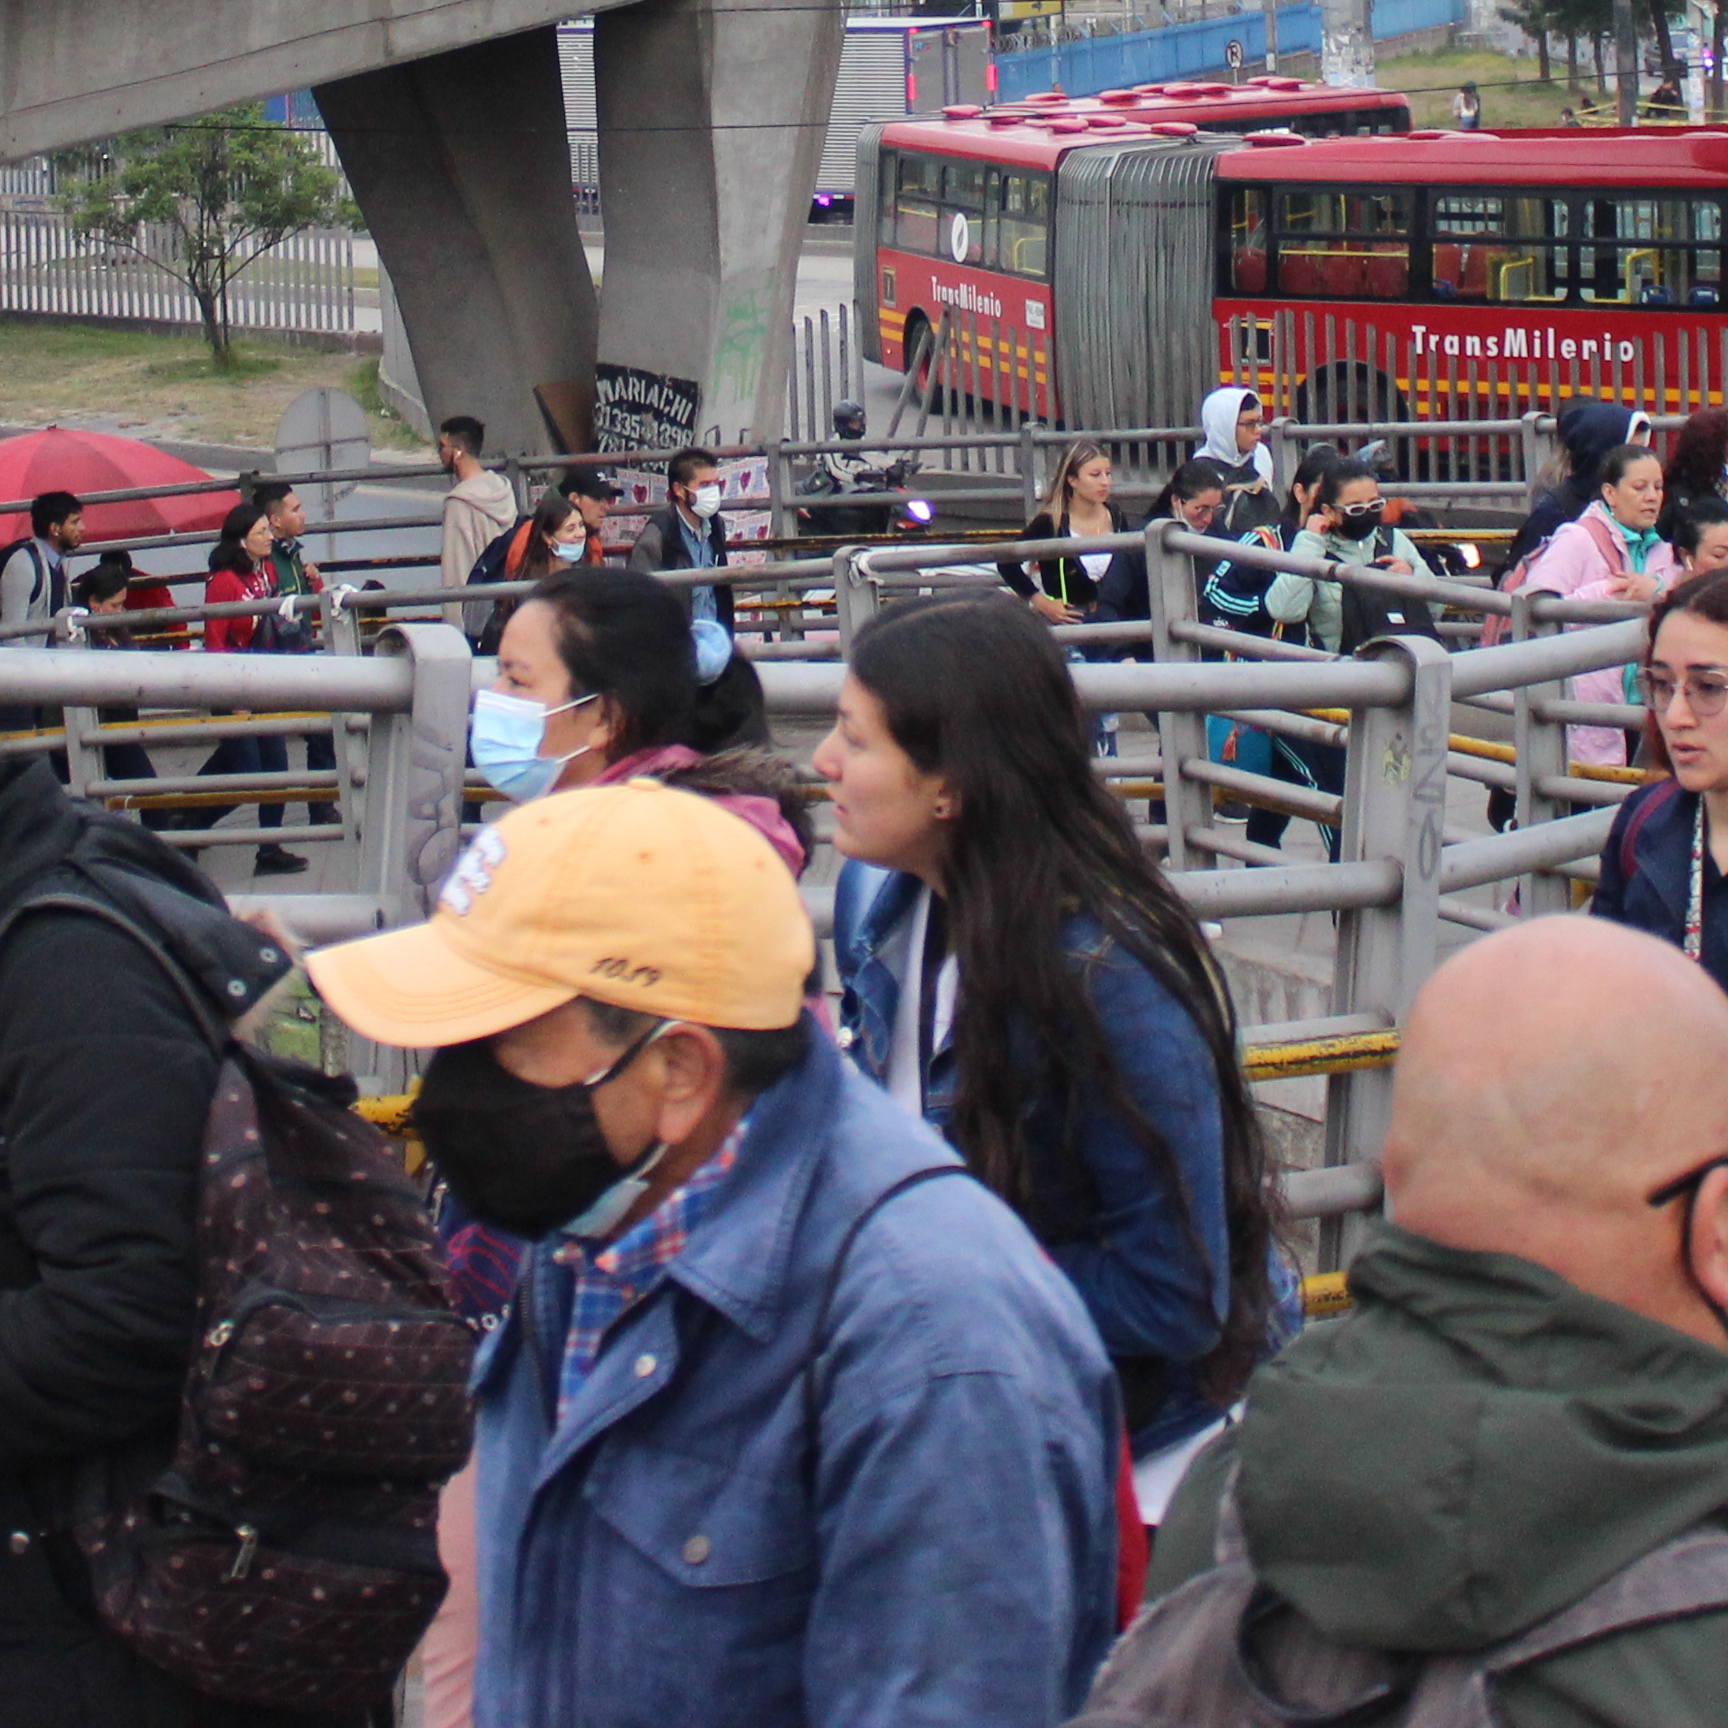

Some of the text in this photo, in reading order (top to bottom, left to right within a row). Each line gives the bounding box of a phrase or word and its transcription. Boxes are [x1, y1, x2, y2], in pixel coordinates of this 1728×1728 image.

[931, 275, 1002, 318] TransMilenio
[1411, 324, 1635, 363] TransMilenio
[596, 375, 693, 425] MARIACHI
